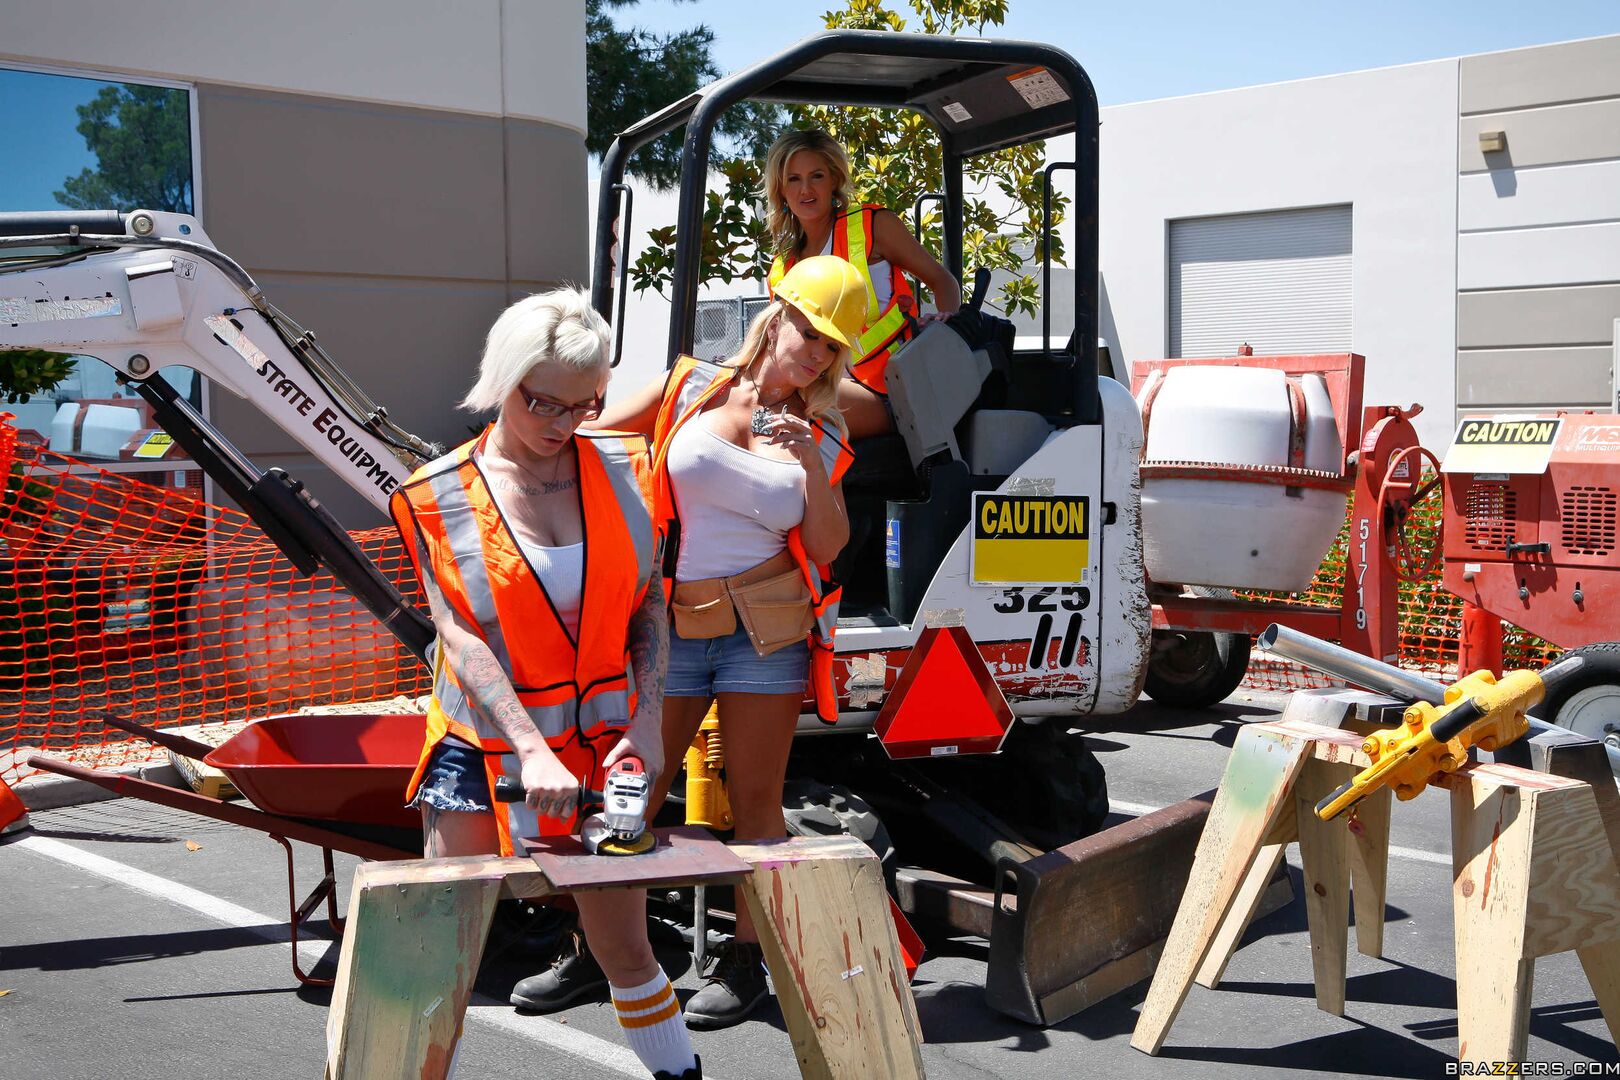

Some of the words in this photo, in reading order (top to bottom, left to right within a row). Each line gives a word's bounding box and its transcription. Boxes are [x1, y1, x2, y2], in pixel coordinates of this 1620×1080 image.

[256, 359, 317, 417] STATE
[1462, 421, 1554, 443] CAUTION
[981, 500, 1084, 534] CAUTION
[1355, 518, 1370, 631] 51719
